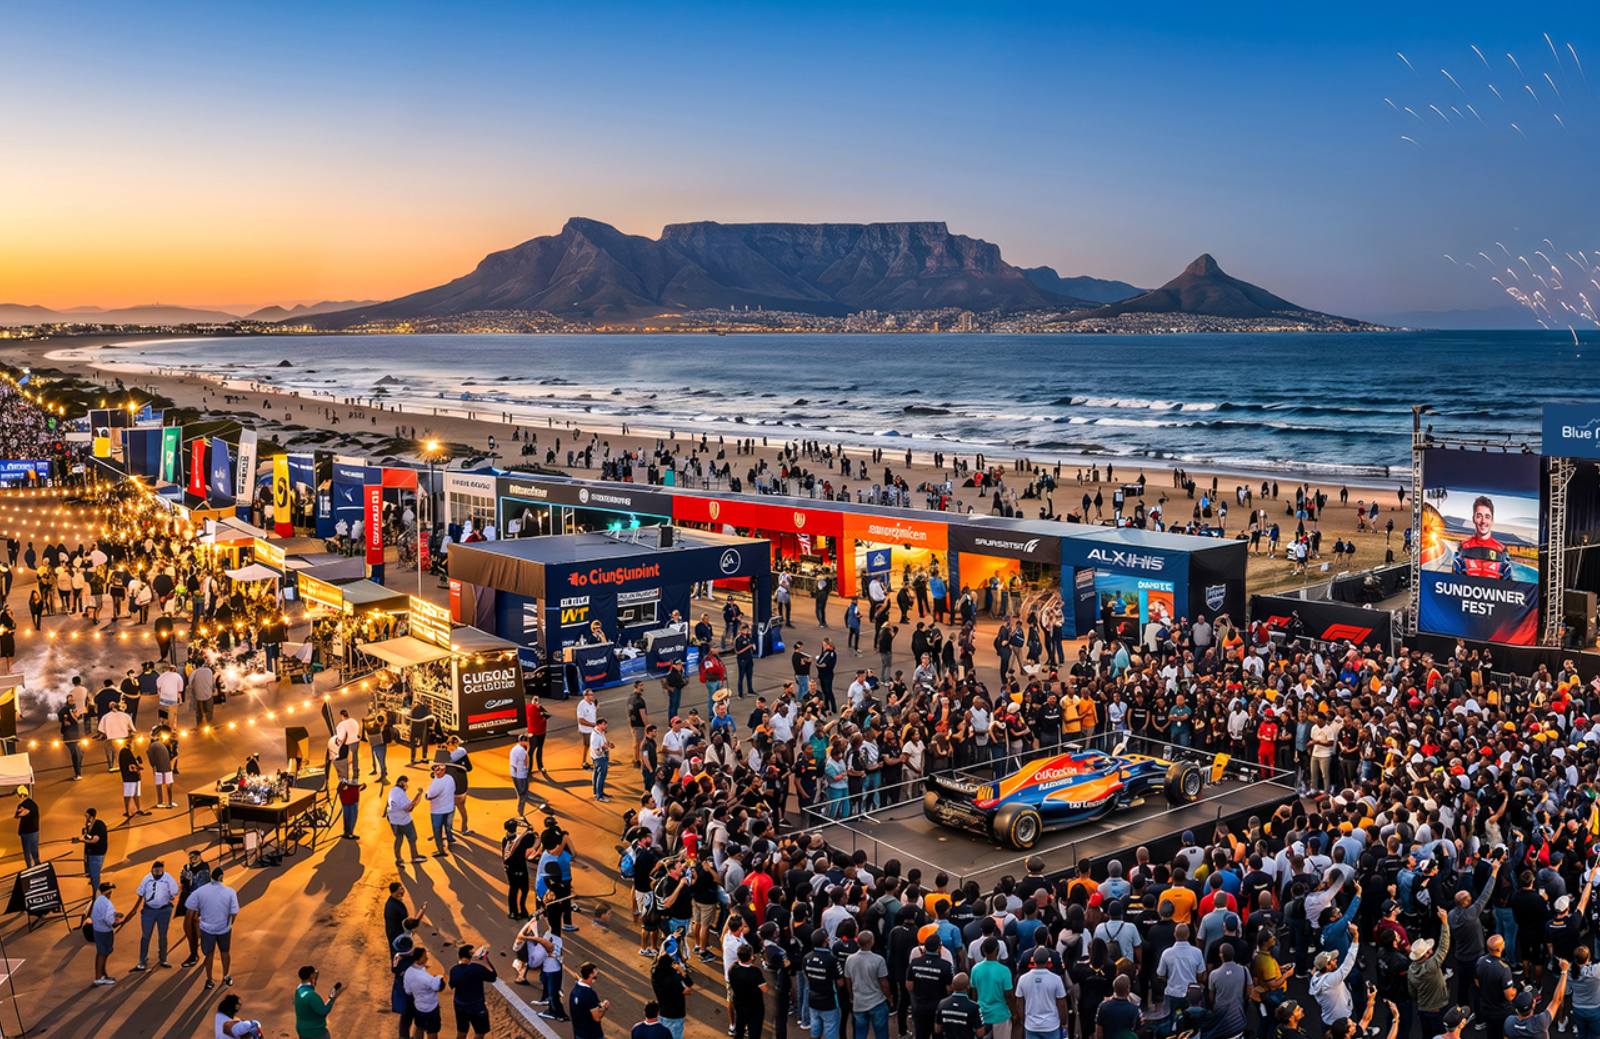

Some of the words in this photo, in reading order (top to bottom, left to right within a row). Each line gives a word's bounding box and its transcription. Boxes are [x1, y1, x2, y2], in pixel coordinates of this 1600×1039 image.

[1562, 425, 1592, 439] Blue
[1435, 581, 1525, 606] SUNDOWNER
[1461, 600, 1495, 616] FEST
